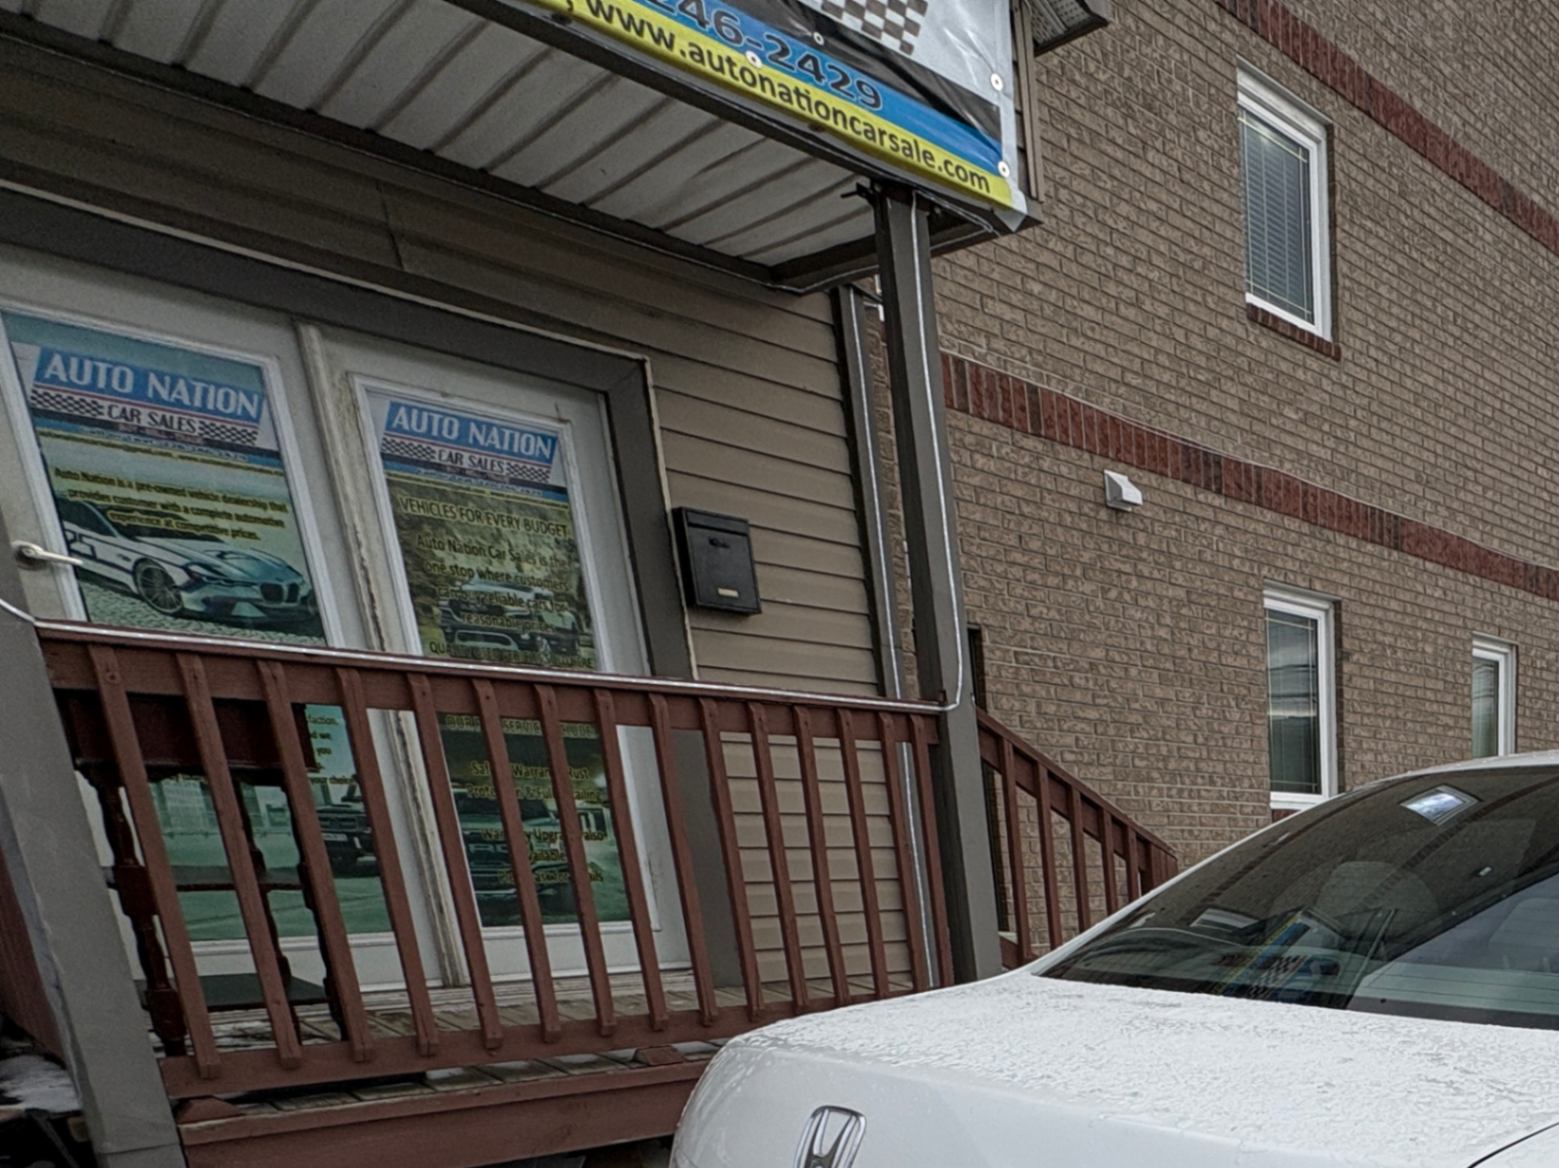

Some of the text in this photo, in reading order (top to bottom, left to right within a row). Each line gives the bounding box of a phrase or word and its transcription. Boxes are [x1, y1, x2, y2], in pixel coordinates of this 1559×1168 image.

[586, 0, 990, 193] www.autonationcarsale.com
[44, 353, 260, 419] AUTO NATION
[107, 404, 141, 424] CAR
[147, 411, 196, 433] SALES
[392, 406, 552, 459] AUTO NATION
[438, 449, 464, 466] CAR
[468, 455, 505, 474] SALES
[401, 499, 568, 537] VEHICLES FOR EVERY BUDGET
[417, 535, 445, 551] Auto
[449, 539, 486, 557] Nation
[488, 545, 506, 561] Car
[425, 560, 569, 593] one stop where customers
